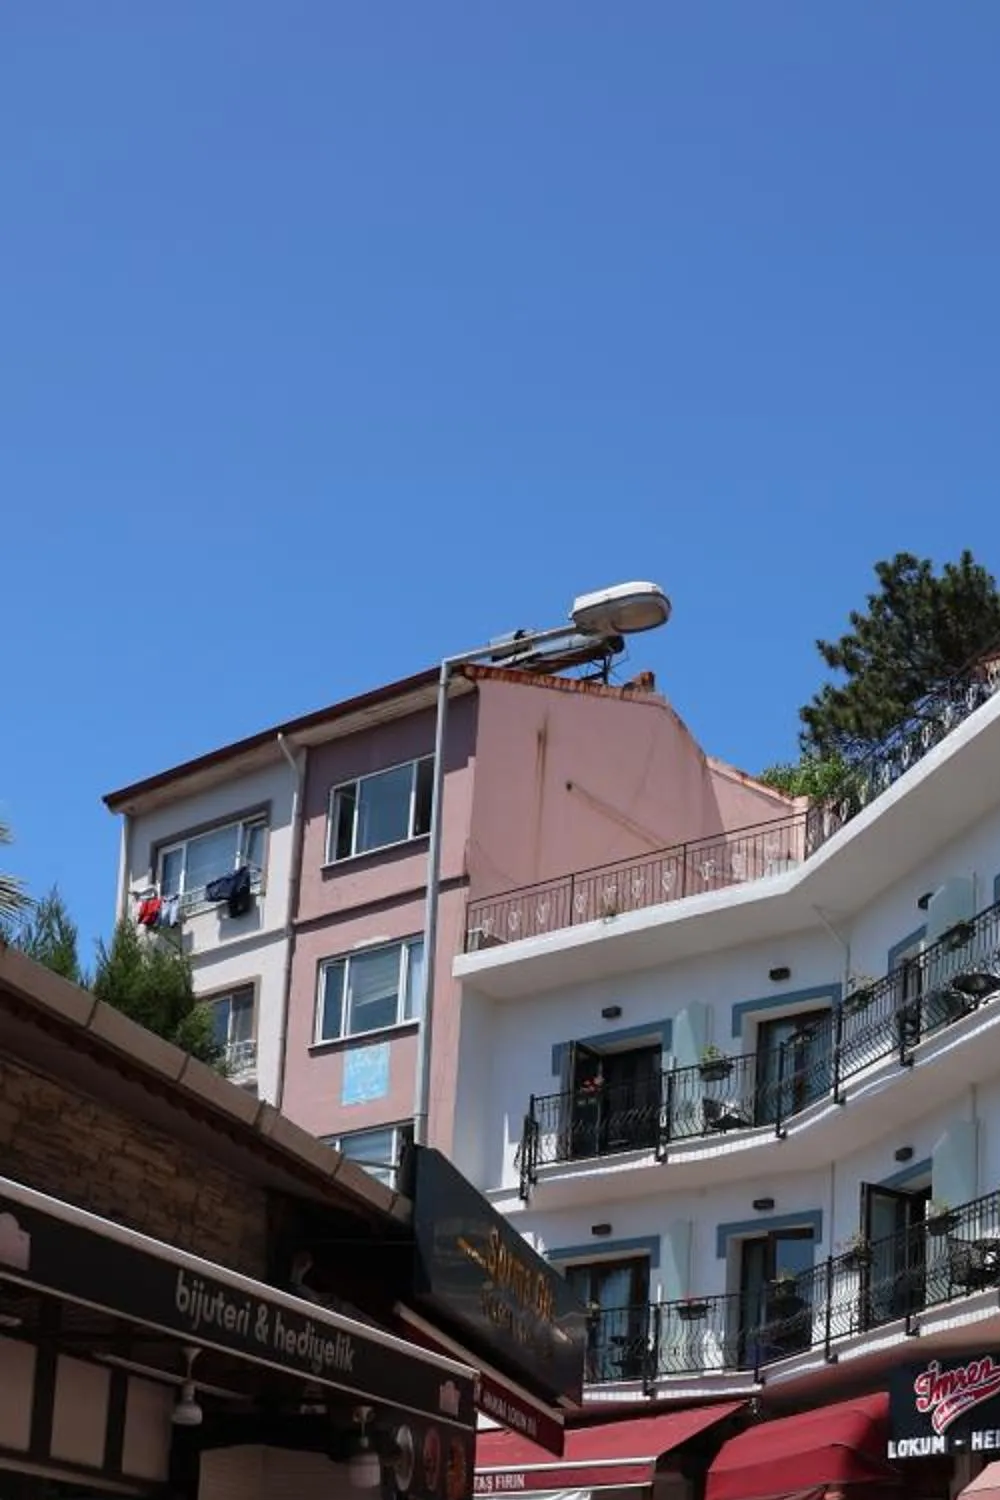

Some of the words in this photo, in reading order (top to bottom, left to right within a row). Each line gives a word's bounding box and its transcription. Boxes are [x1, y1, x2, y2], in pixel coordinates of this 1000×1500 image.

[176, 1269, 250, 1337] bijuteri
[255, 1305, 269, 1344] &
[274, 1311, 354, 1373] hediyelik
[888, 1435, 945, 1458] LOKUM
[496, 1473, 525, 1489] FIRIN
